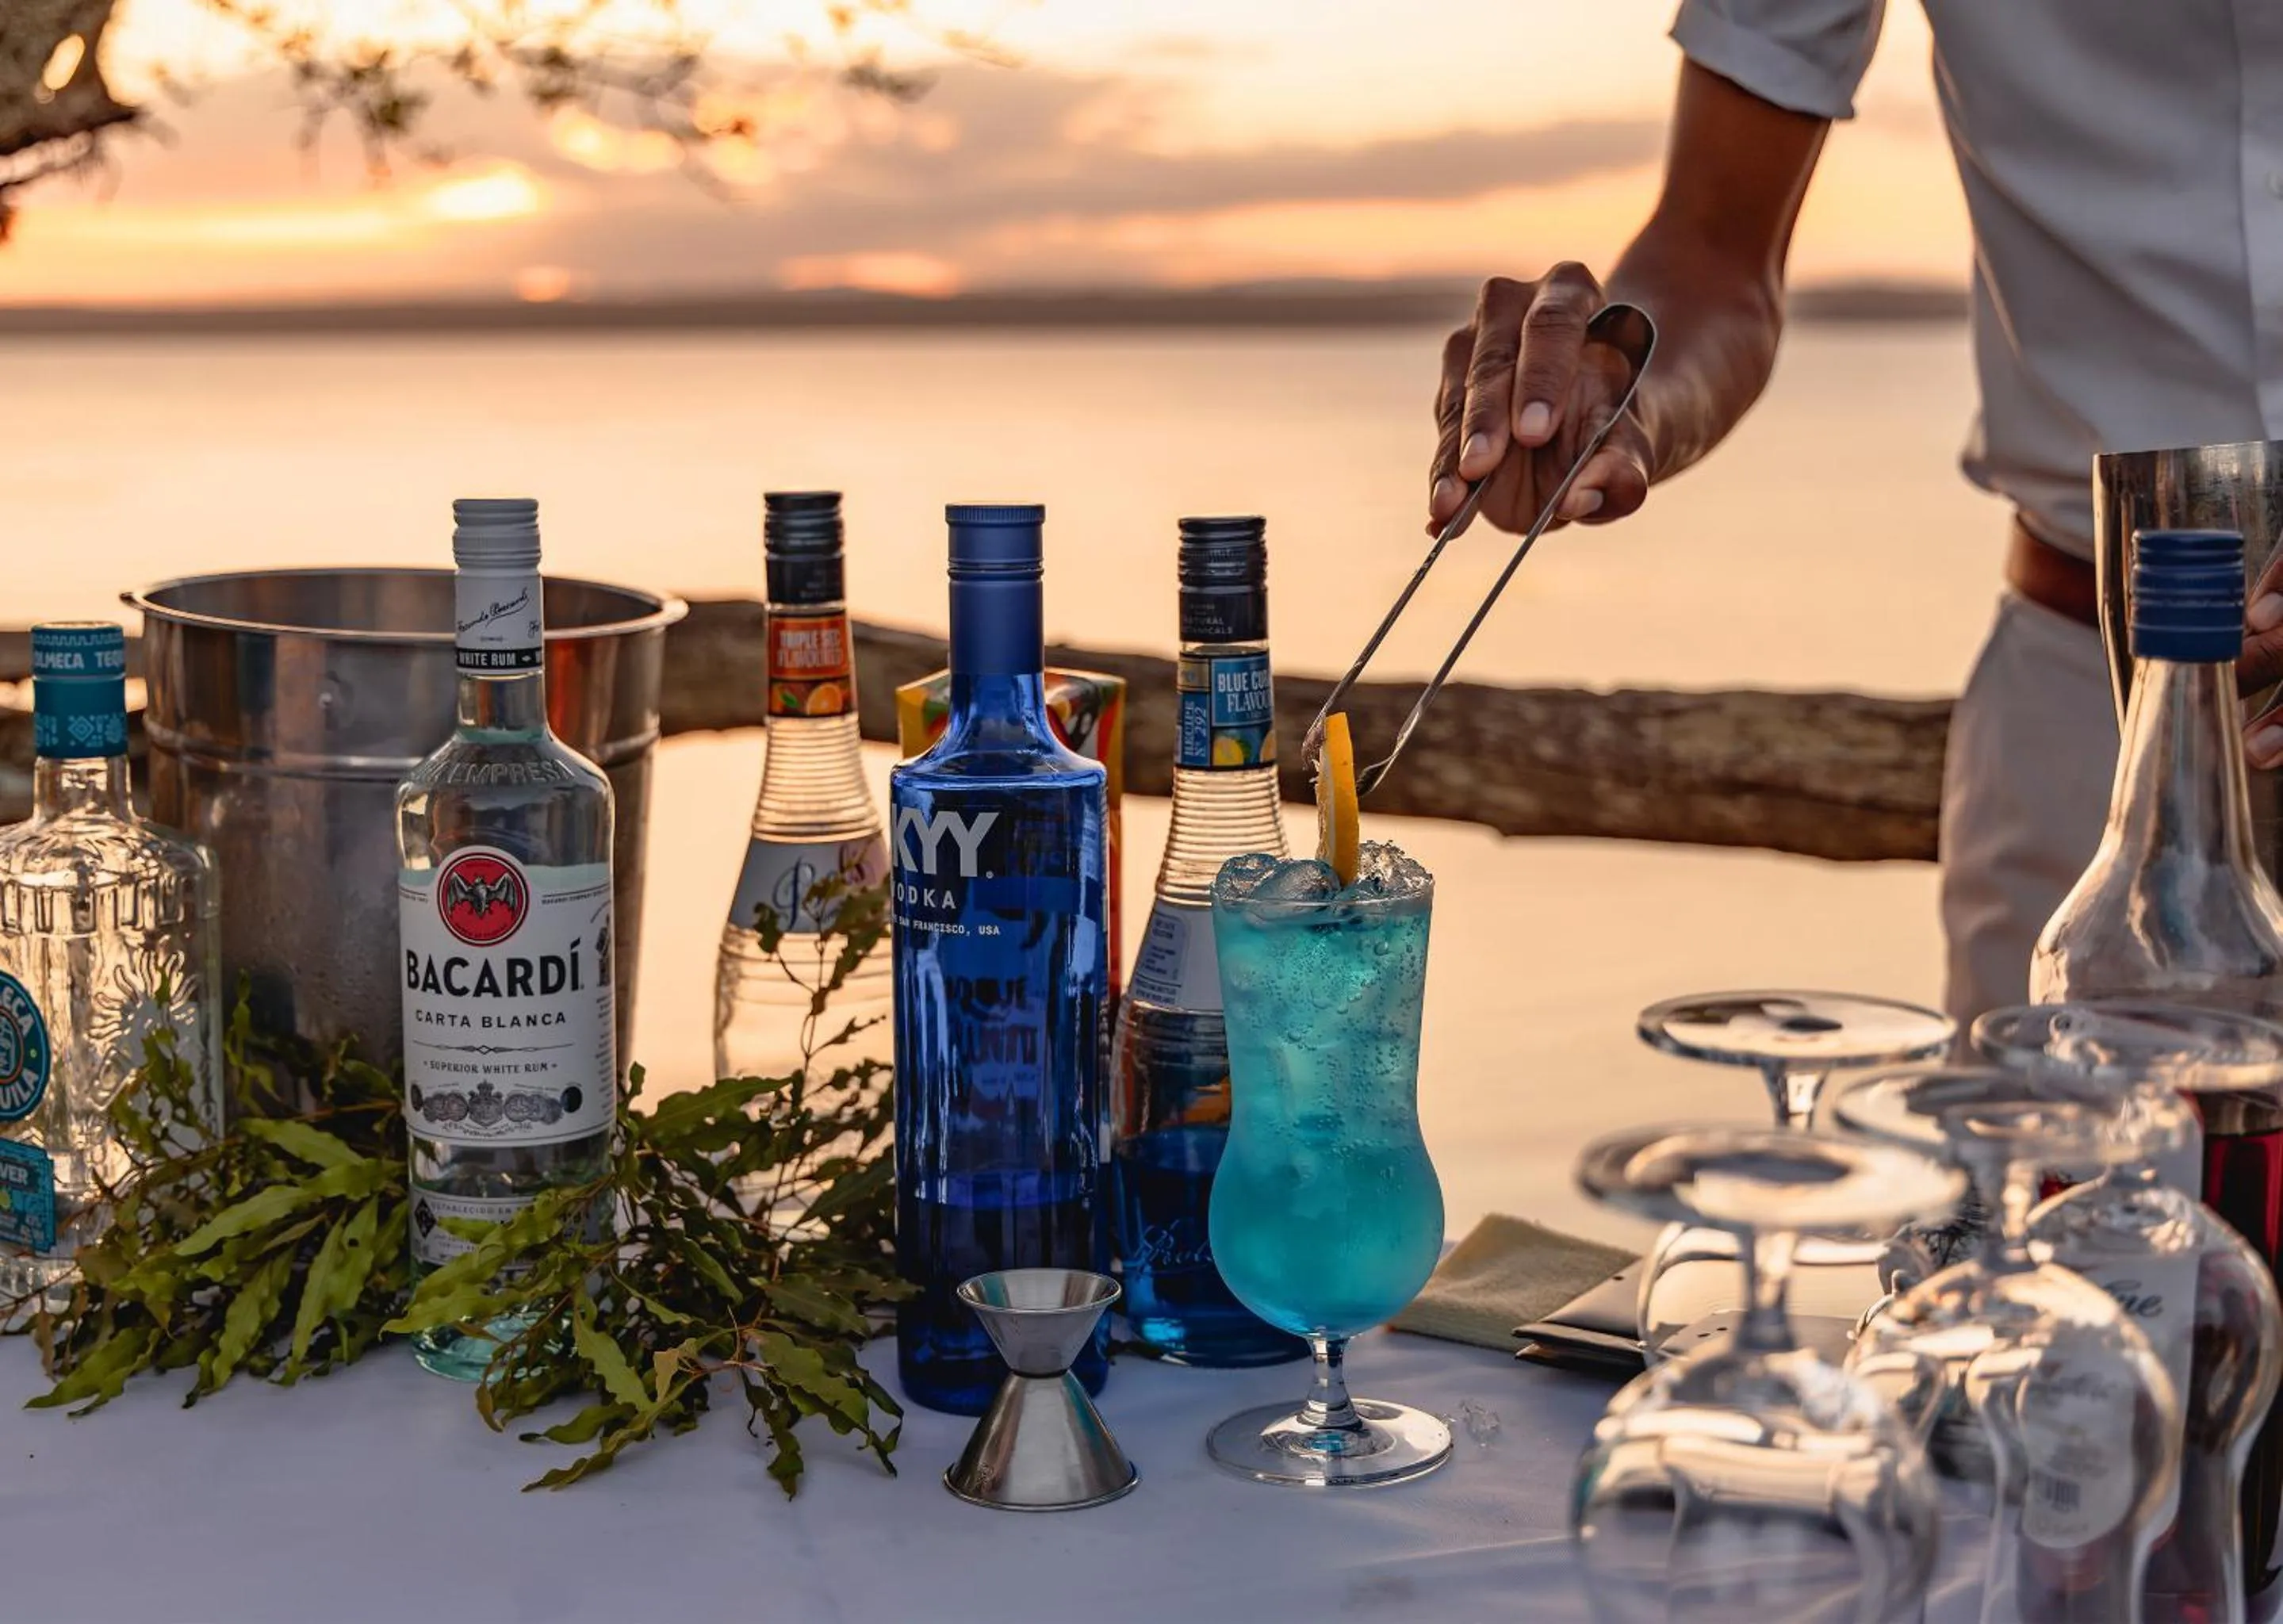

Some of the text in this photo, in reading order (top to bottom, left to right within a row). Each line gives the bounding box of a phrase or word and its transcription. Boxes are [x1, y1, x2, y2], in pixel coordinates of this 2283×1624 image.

[458, 653, 516, 667] WHITE RUM
[1218, 672, 1249, 692] BLUE
[892, 803, 999, 878] KYY
[913, 920, 971, 936] FRANCISCO,
[979, 925, 1001, 936] USA
[407, 938, 580, 998] BACARDÍ
[0, 985, 35, 1037] ECA
[416, 1009, 566, 1029] CARTA BLANCA
[430, 1060, 548, 1074] SUPERIOR WHITE RUM
[0, 1067, 40, 1110] UILA
[0, 1162, 29, 1186] VER
